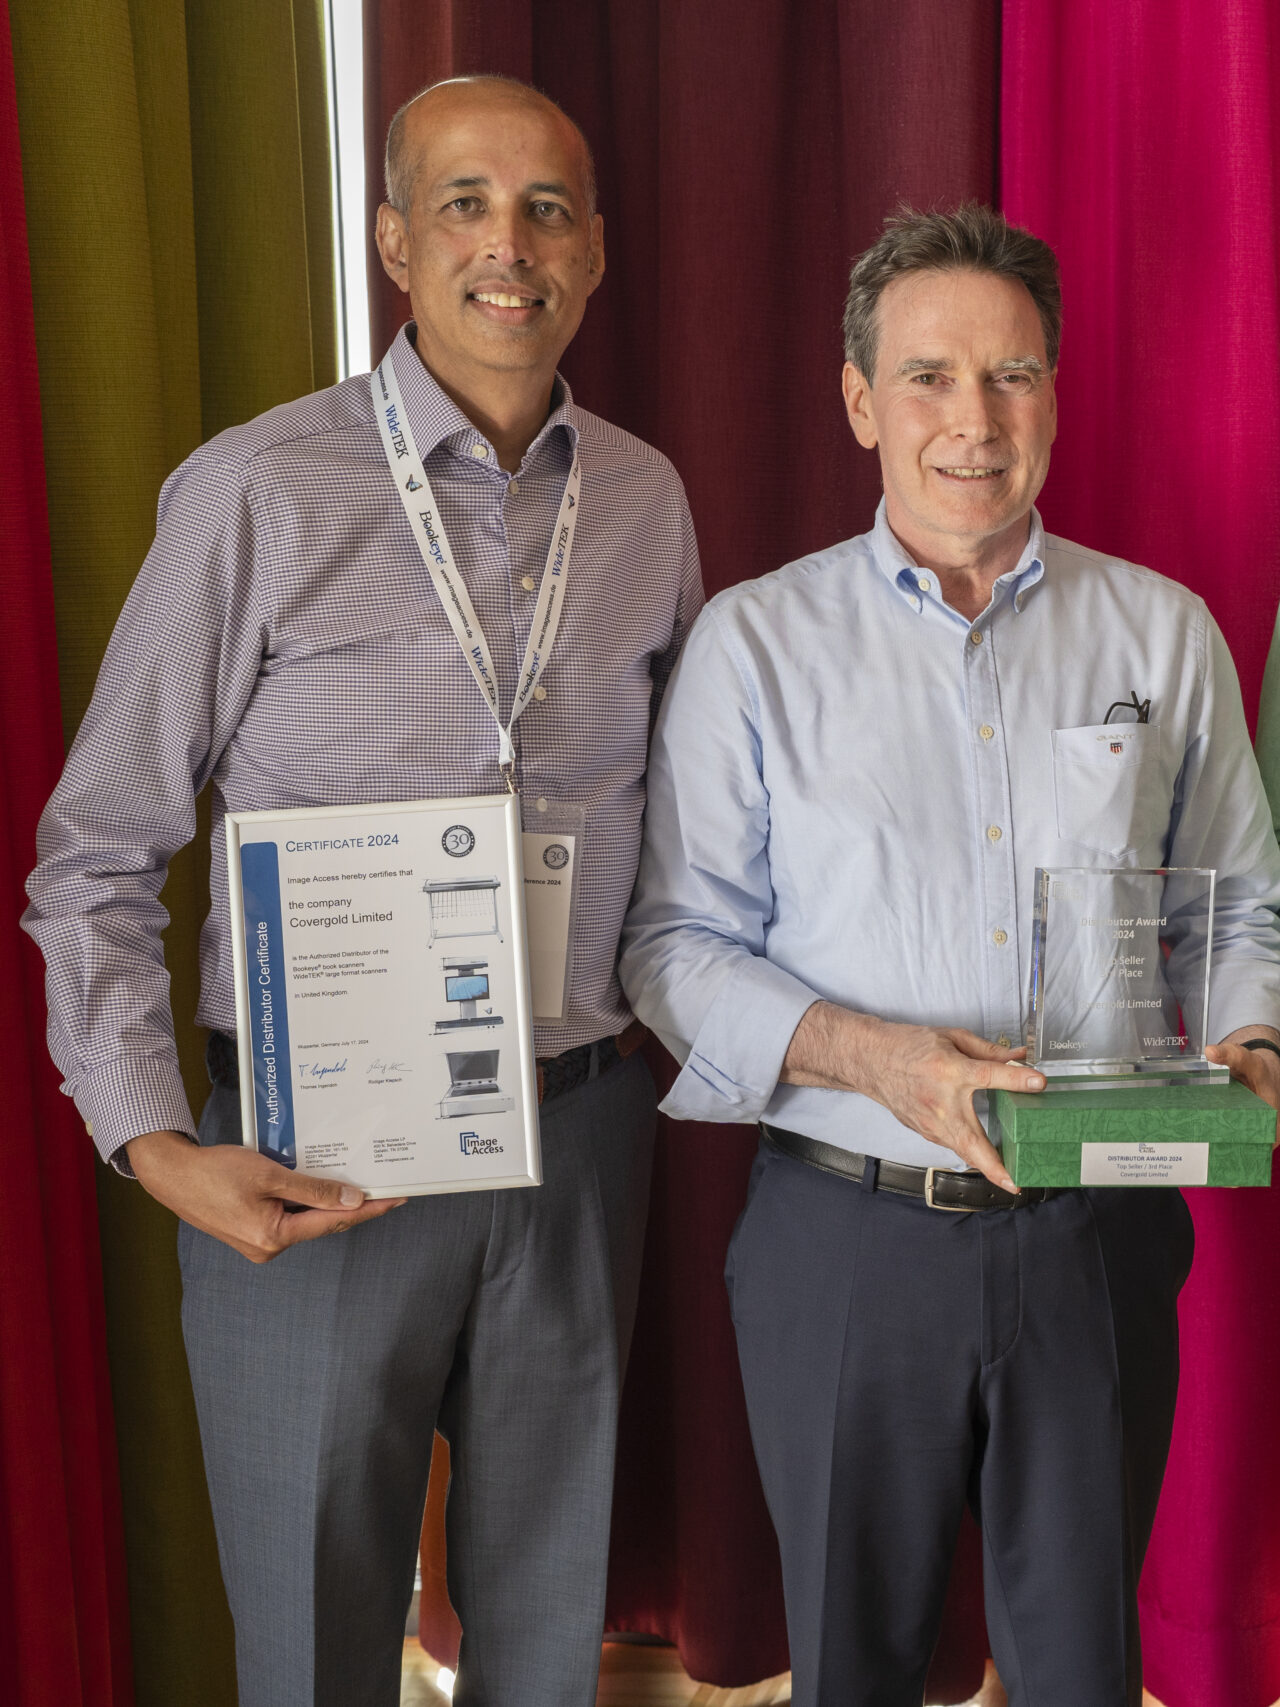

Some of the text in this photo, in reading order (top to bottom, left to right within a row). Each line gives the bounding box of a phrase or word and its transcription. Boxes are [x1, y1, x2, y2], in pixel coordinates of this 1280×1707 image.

[384, 404, 409, 460] WideTEK
[419, 510, 447, 566] Bookeye
[440, 569, 473, 639] www.imageaccess.de
[471, 646, 497, 706] WideTEK
[538, 584, 557, 649] www.imageaccess.de
[552, 524, 569, 577] WideTEK
[286, 834, 399, 852] CERTIFICATE 2024
[449, 833, 470, 850] 30
[548, 851, 565, 863] 30
[287, 877, 310, 885] Image
[369, 870, 397, 878] certifies
[289, 898, 352, 909] the company
[290, 911, 393, 927] Covergold Limited
[1136, 917, 1167, 926] Award
[1112, 930, 1135, 939] 2024
[1120, 955, 1145, 965] Seller
[1119, 969, 1143, 978] Place
[321, 989, 348, 997] Kingdom
[1127, 999, 1162, 1009] Limited
[256, 921, 279, 1125] Authorized Distributor Certificate
[467, 1138, 498, 1147] Image
[472, 1146, 504, 1155] Access
